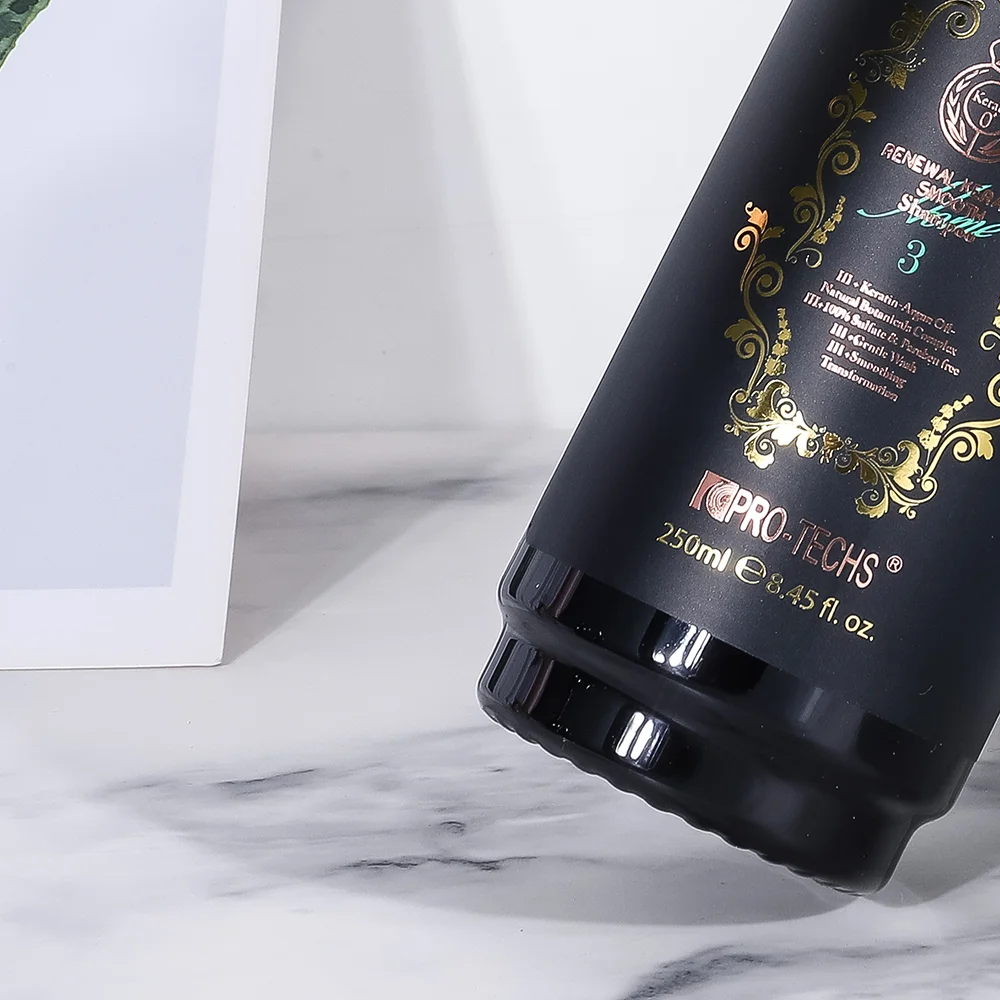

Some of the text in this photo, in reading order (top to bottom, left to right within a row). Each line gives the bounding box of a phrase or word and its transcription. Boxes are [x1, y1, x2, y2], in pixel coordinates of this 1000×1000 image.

[880, 142, 957, 187] RENEWAL
[916, 180, 987, 221] SMOOTH
[897, 239, 927, 274] 3
[820, 280, 860, 308] Natural
[913, 326, 958, 357] Complex
[850, 313, 887, 341] Sulfate
[940, 358, 961, 377] free
[890, 350, 918, 374] Wash
[819, 354, 899, 402] Transformation
[655, 521, 732, 573] 250ml
[765, 573, 820, 611] 8.45
[819, 596, 840, 625] fl.
[844, 614, 875, 642] oz.
